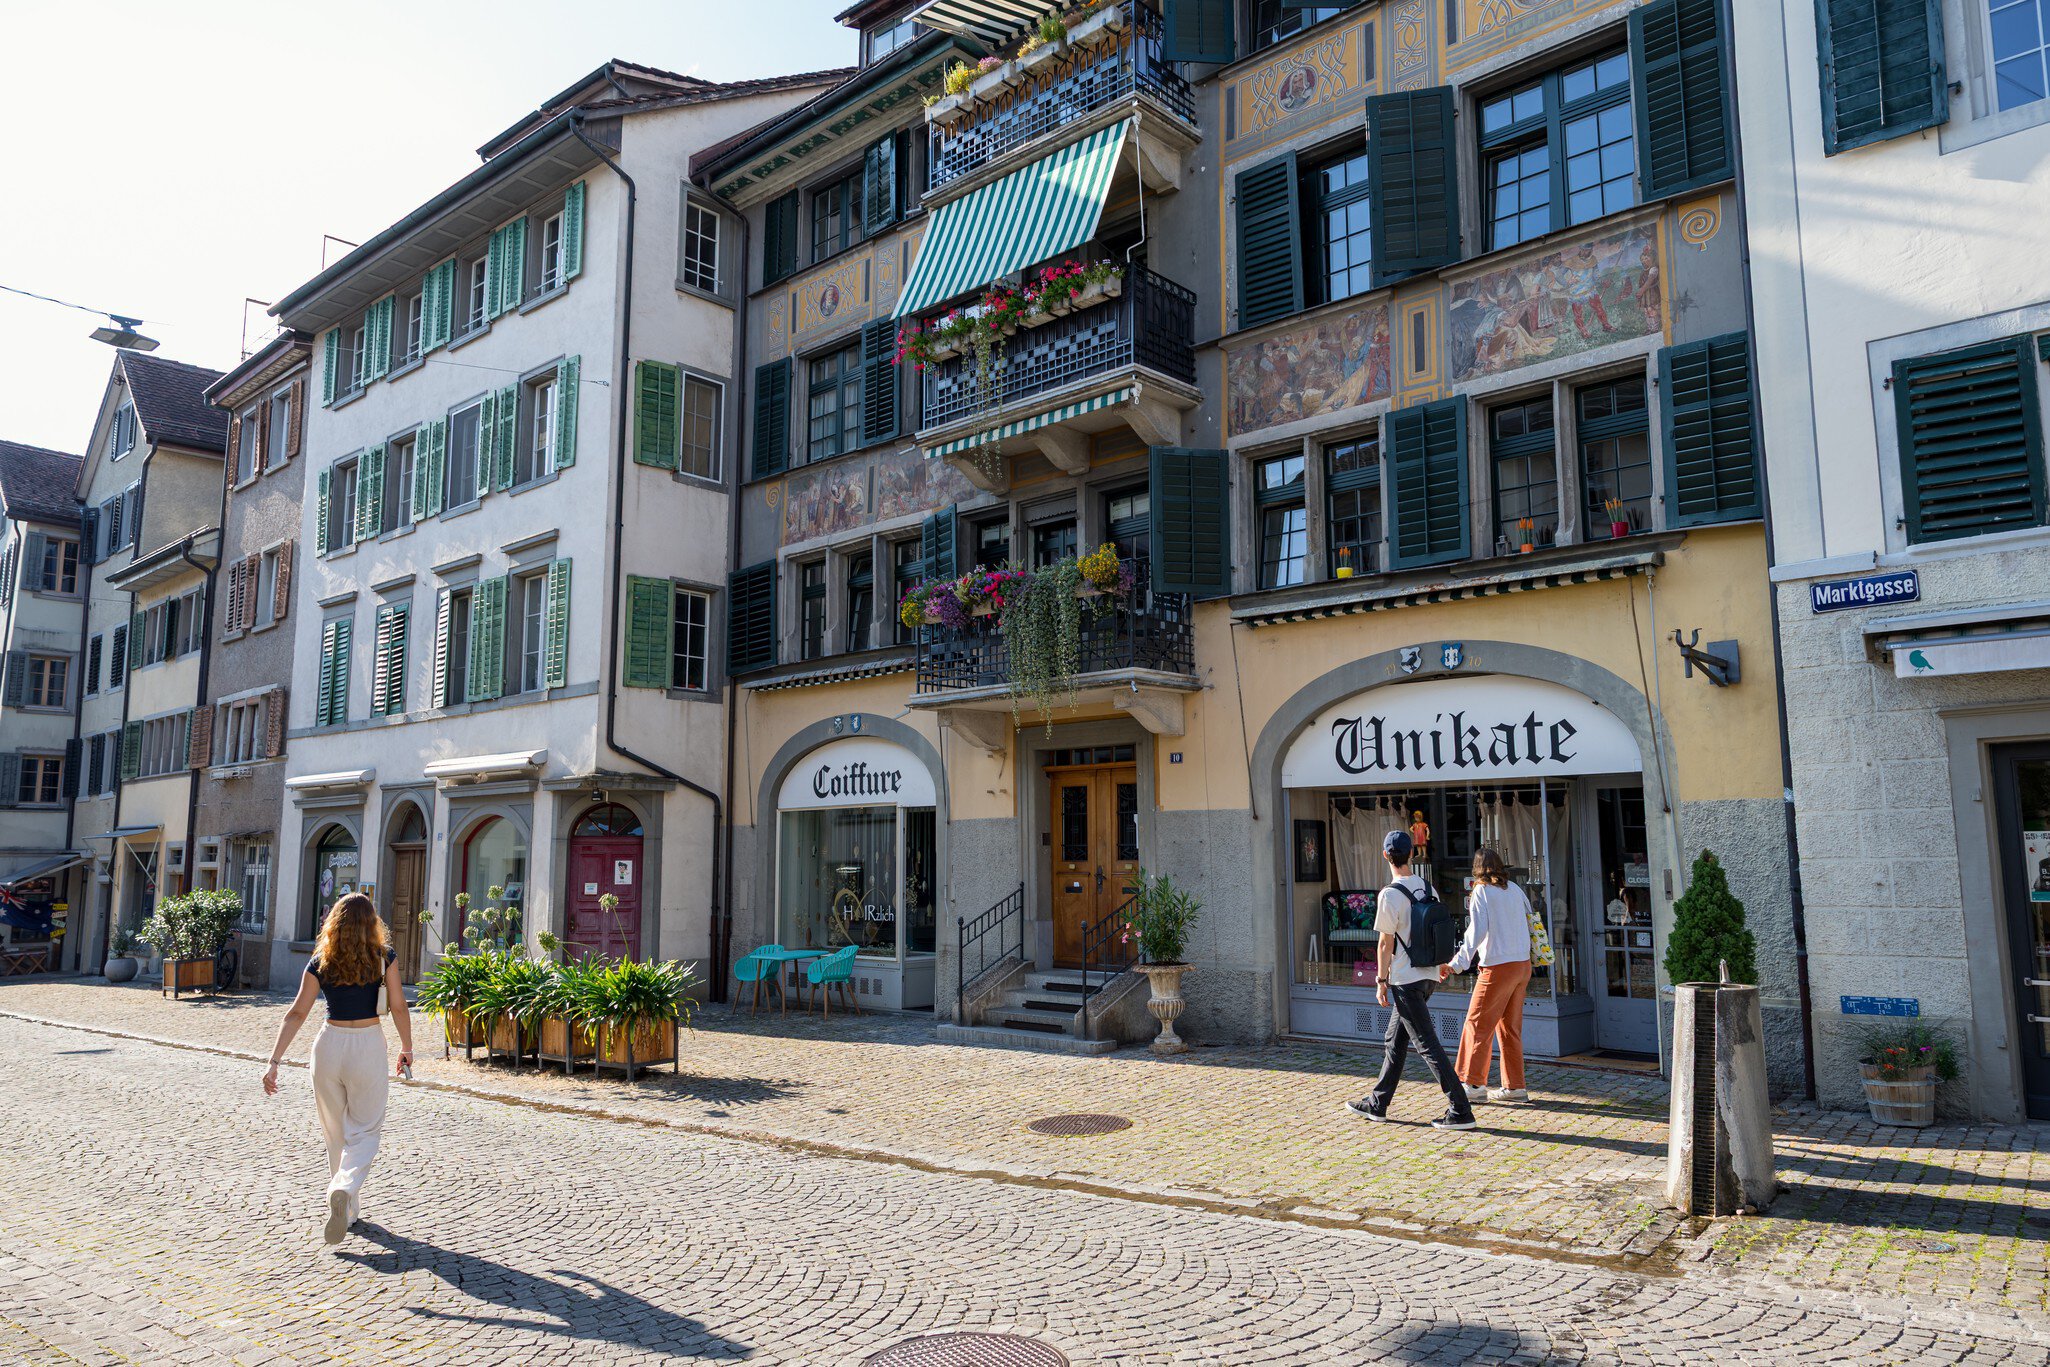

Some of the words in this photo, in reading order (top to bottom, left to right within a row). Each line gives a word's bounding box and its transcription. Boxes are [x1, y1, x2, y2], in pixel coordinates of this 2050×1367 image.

[1815, 578, 1914, 605] Marktgasse
[1173, 754, 1180, 762] 10
[1332, 710, 1578, 774] Unikate
[813, 762, 902, 799] Coiffure
